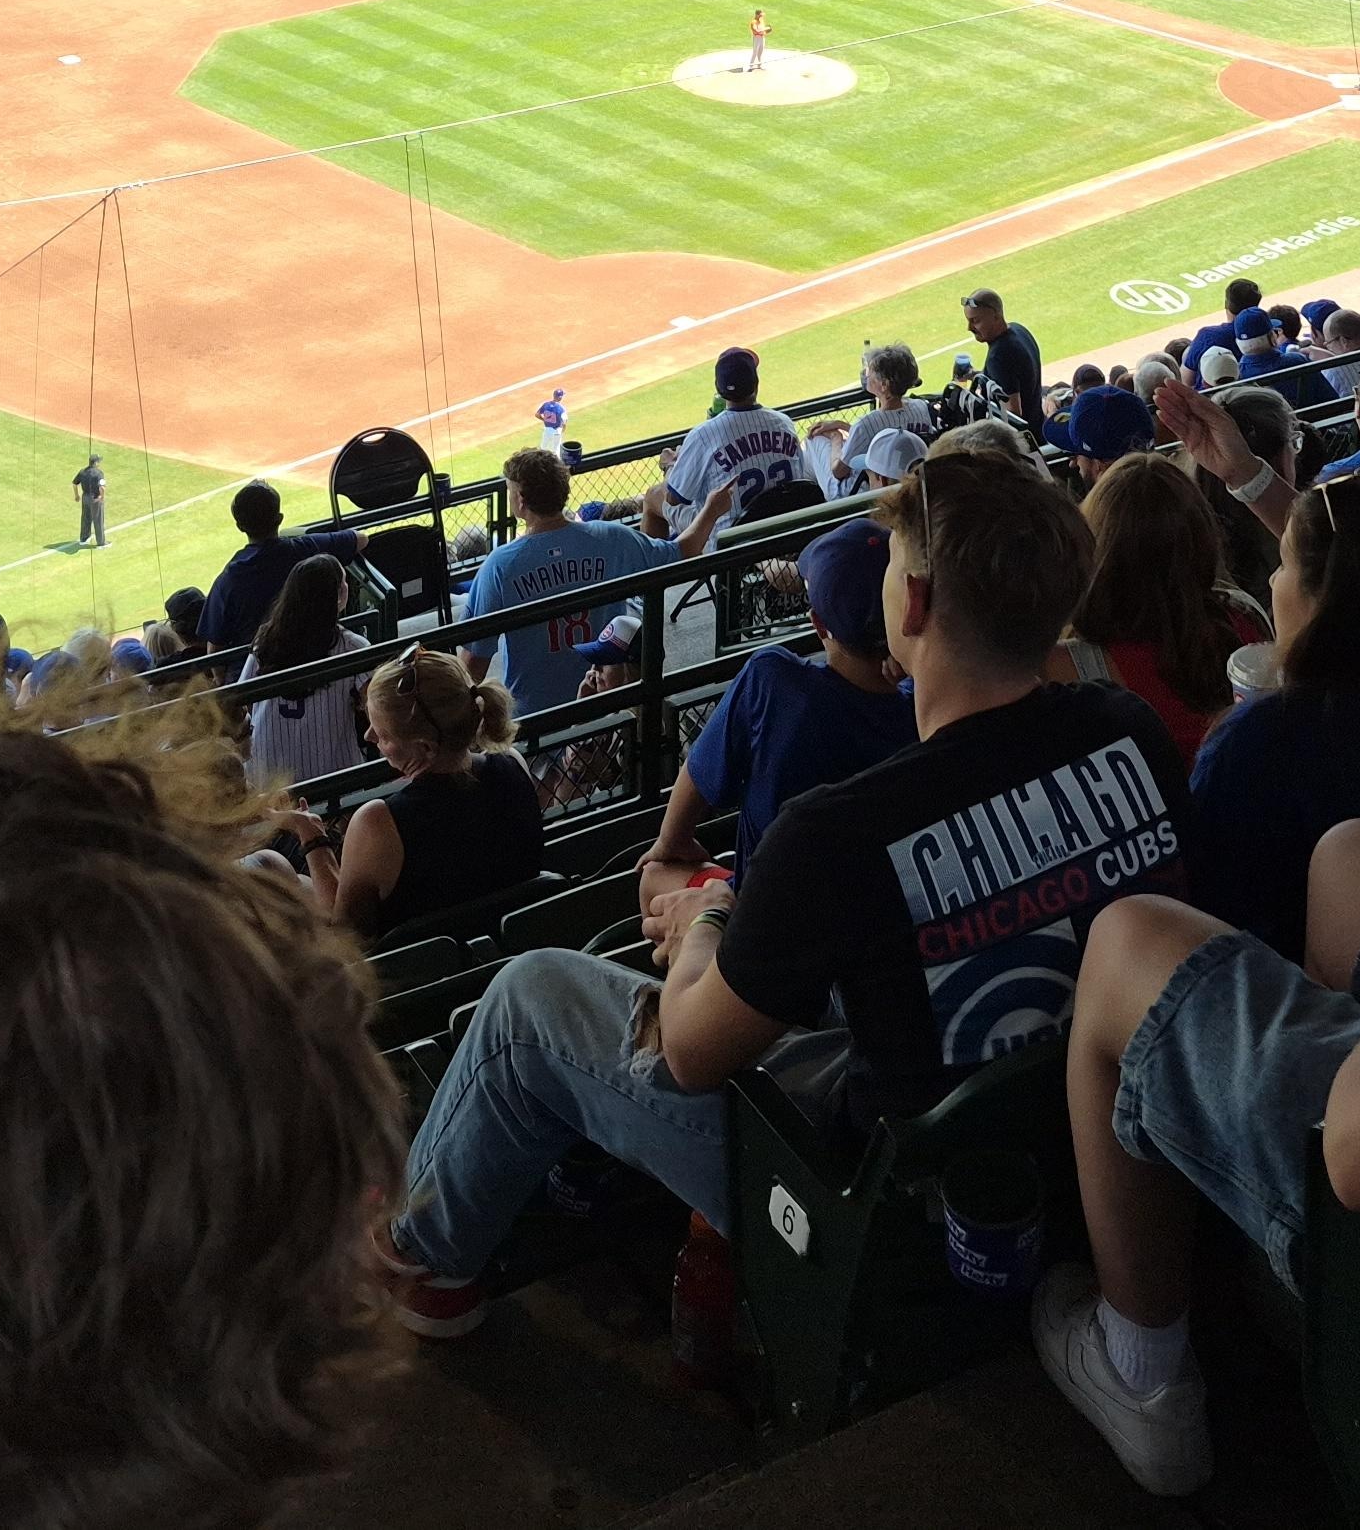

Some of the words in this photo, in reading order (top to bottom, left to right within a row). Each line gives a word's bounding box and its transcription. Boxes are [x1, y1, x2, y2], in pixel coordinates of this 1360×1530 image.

[513, 558, 606, 601] IMANAGA
[547, 608, 592, 652] 18
[911, 750, 1162, 920] CHICAGO
[1095, 820, 1178, 887] CUBS
[918, 866, 1089, 960] CHICAGO
[782, 1204, 796, 1235] 6
